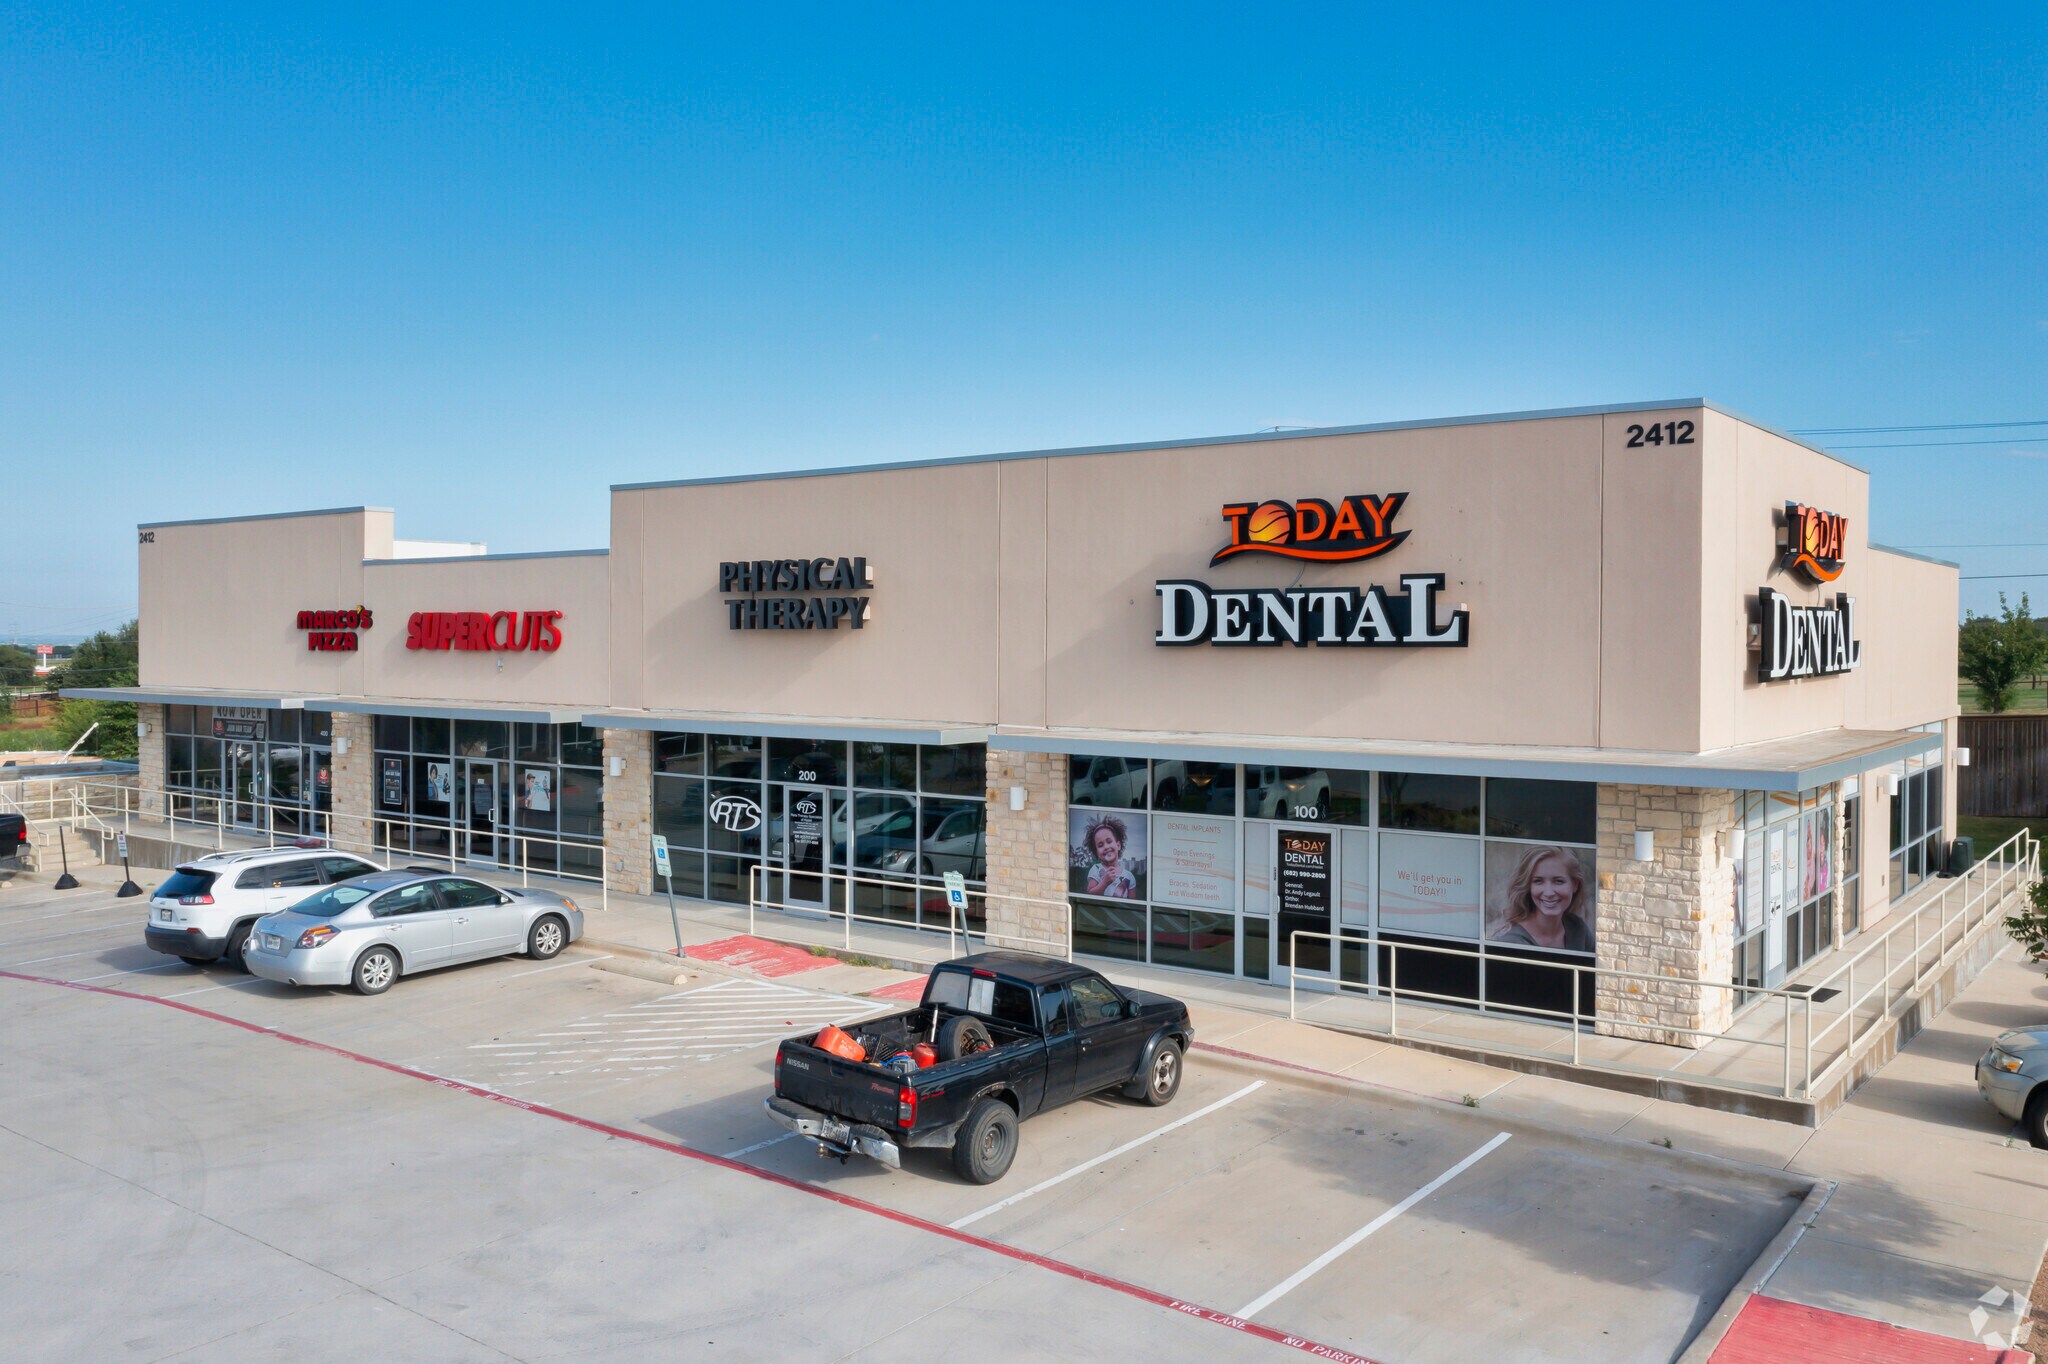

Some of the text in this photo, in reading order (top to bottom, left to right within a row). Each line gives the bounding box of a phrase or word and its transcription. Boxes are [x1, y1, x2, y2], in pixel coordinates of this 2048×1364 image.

[1627, 420, 1695, 448] 2412
[1222, 495, 1400, 546] TODAY
[140, 531, 155, 543] 2412
[1795, 505, 1848, 561] TODAY
[720, 557, 873, 592] PHYSICAL
[297, 606, 373, 629] MARCO'S
[725, 597, 869, 630] THERAPY
[1156, 576, 1463, 645] DENTAL
[405, 610, 562, 651] SUPERCUTS
[1768, 591, 1861, 679] DENTAL
[308, 632, 358, 651] PIZZA
[216, 706, 262, 719] NOW OPEN
[798, 770, 817, 782] 200
[711, 796, 762, 832] RTS
[797, 801, 817, 814] RTS
[1294, 805, 1318, 819] 100
[1168, 823, 1222, 834] DENTAL IMPLANTS
[1285, 838, 1326, 852] TODAY
[1173, 848, 1216, 860] Open Evenings
[1284, 852, 1325, 865] DENTAL
[1283, 870, 1298, 878] (682)
[1397, 869, 1462, 886] We'll get you in
[1191, 881, 1218, 890] Sedation
[1181, 890, 1203, 898] Wisdom
[1204, 893, 1220, 901] teeth
[1292, 889, 1304, 897] Andy
[786, 1058, 810, 1071] NISSAN
[1169, 1301, 1372, 1364] FIRE LANE NO PARKIN
